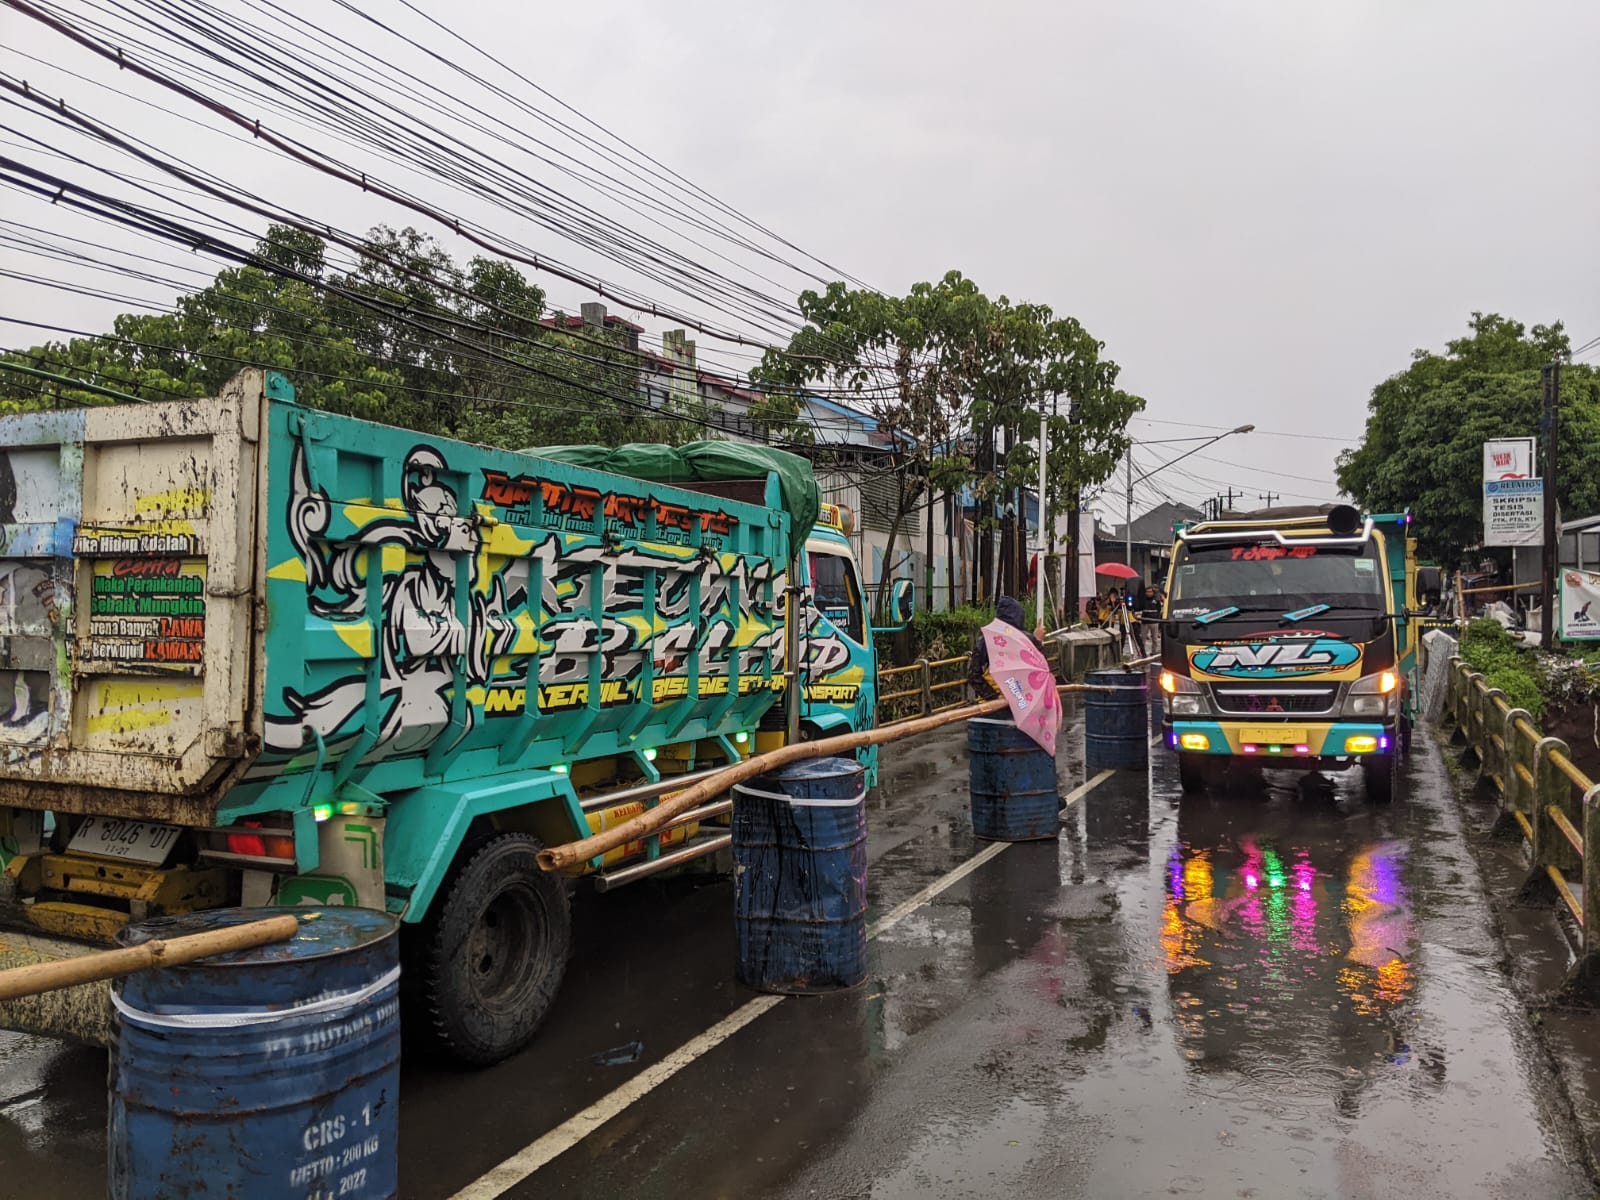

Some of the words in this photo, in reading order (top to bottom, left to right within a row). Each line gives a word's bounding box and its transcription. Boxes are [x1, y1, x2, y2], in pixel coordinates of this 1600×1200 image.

[100, 536, 138, 553] Hidup
[113, 557, 180, 577] Cerita
[94, 576, 125, 593] Maka
[91, 597, 137, 615] Sebaik
[119, 619, 160, 638] Banyak
[92, 641, 144, 660] Berwujud
[78, 817, 96, 838] R
[101, 820, 144, 845] 8046
[150, 827, 179, 850] DT
[303, 1115, 346, 1151] CRS
[361, 1102, 370, 1127] 1
[342, 1143, 362, 1168] 200
[363, 1135, 379, 1157] KG
[339, 1168, 367, 1196] 2022
